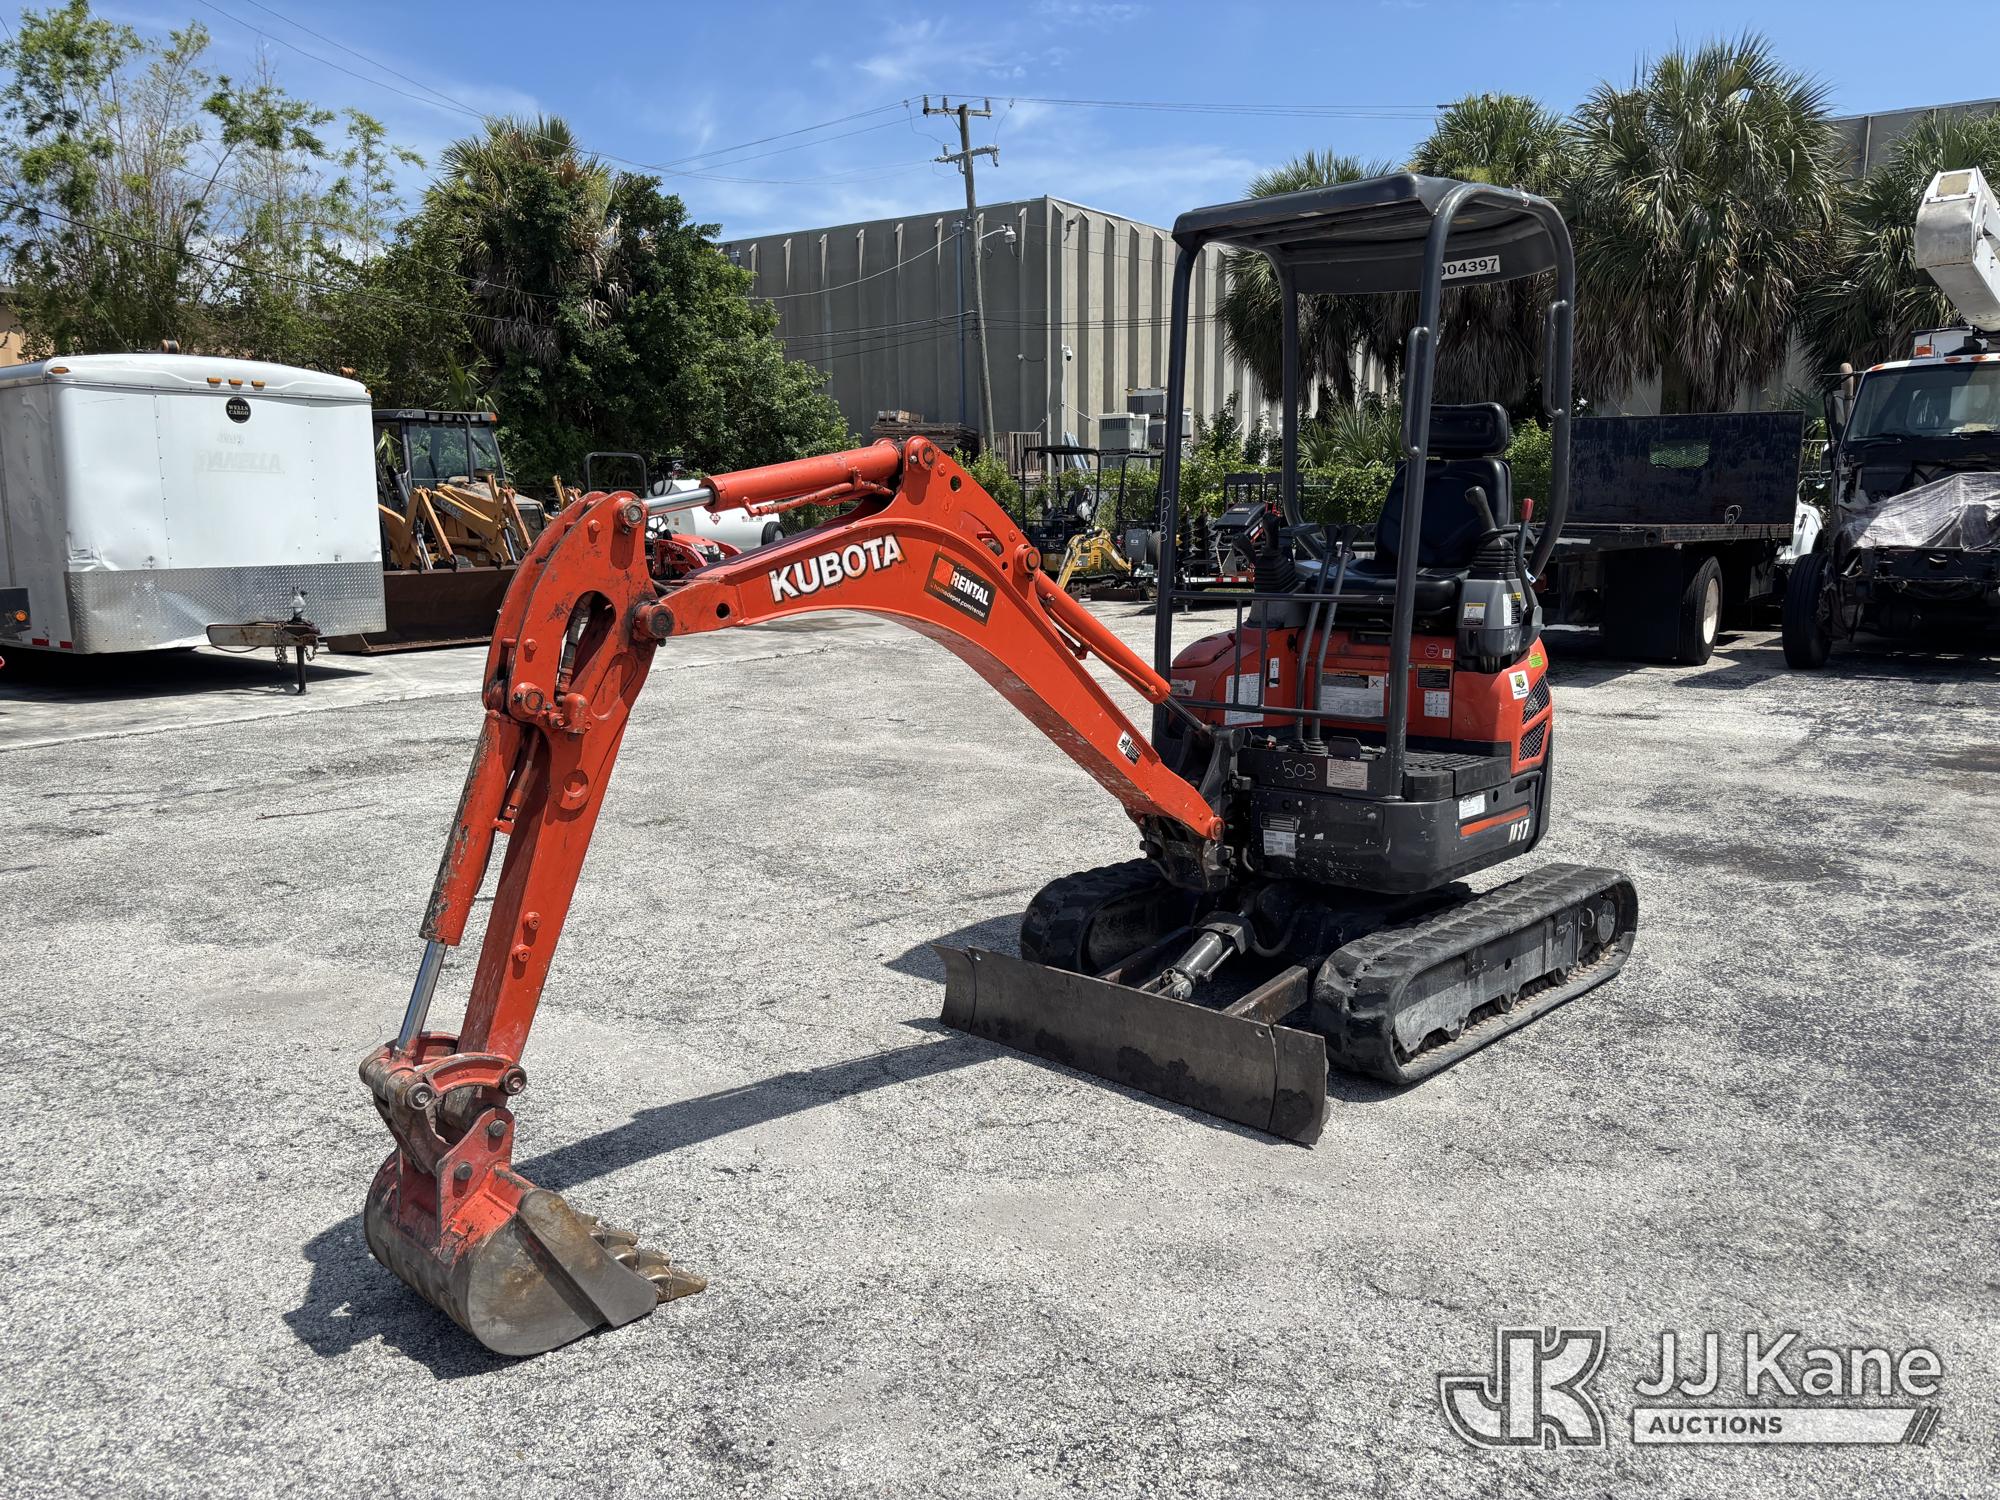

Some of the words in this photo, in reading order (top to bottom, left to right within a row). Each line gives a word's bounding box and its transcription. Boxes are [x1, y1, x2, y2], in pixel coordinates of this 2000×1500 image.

[1160, 490, 1171, 543] 503
[768, 533, 906, 603] KUBOTA
[950, 570, 989, 606] RENTAL
[1281, 759, 1317, 781] 503
